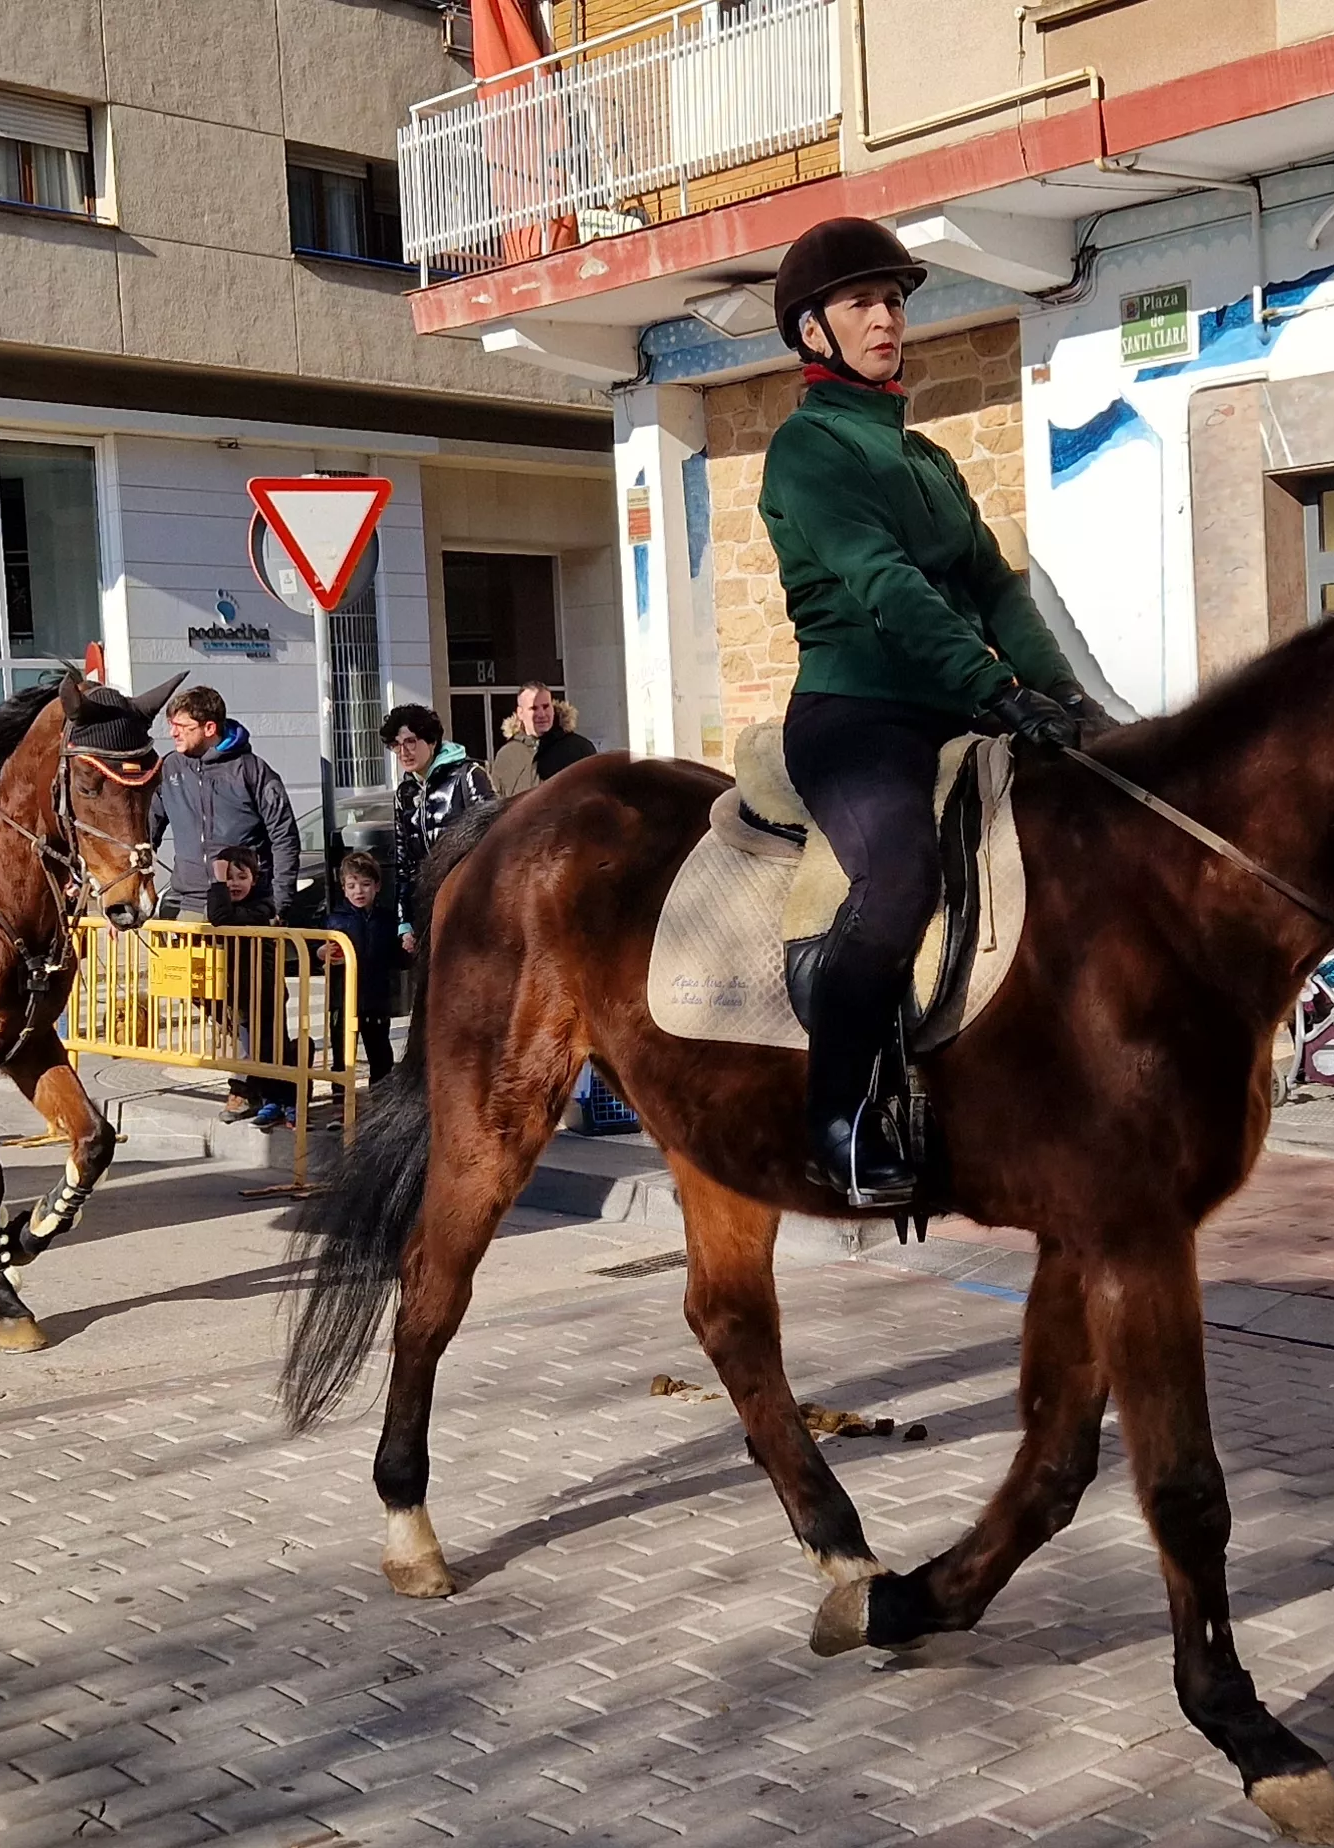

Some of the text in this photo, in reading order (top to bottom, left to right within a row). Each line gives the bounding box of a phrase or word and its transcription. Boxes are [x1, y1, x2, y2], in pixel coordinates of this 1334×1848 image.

[1142, 293, 1179, 311] Plaza
[1150, 313, 1165, 328] de
[1121, 325, 1188, 355] SANTA CLARA
[188, 622, 270, 647] podoactiva
[477, 660, 496, 683] 84
